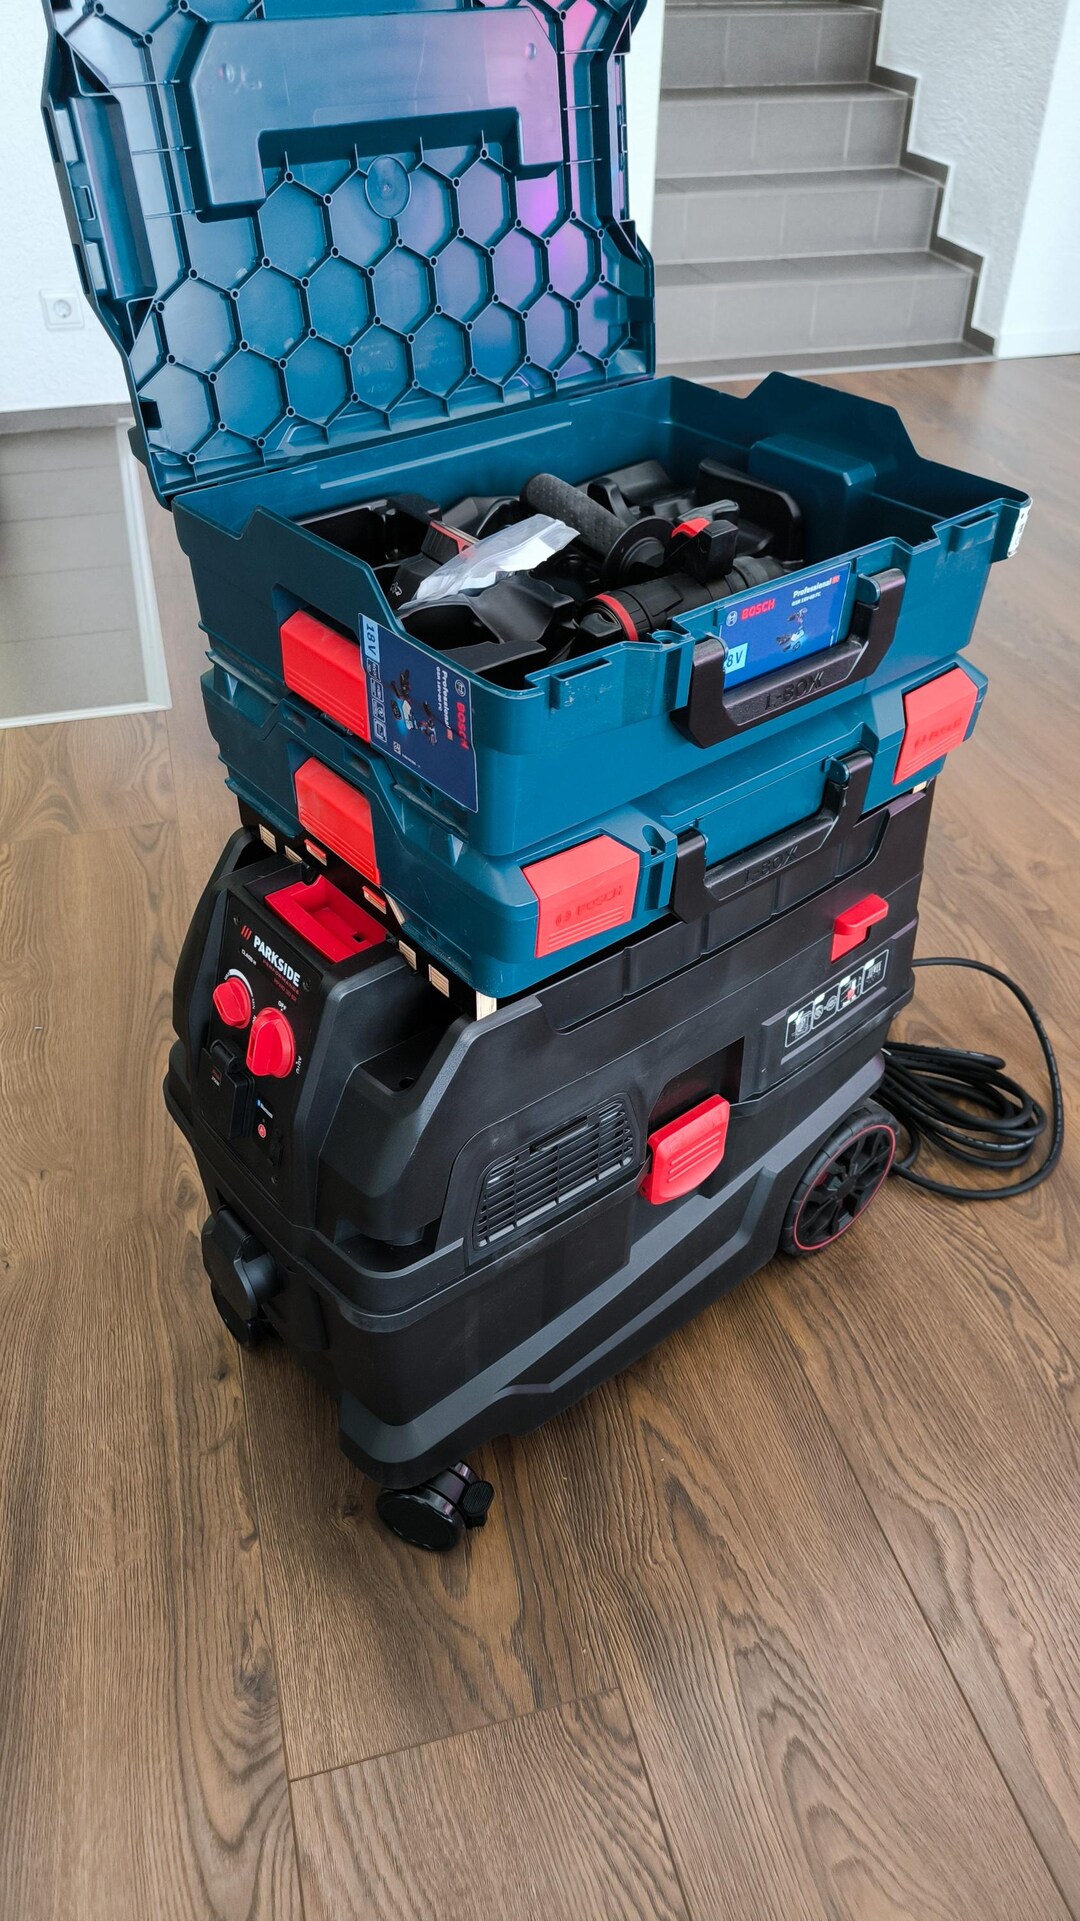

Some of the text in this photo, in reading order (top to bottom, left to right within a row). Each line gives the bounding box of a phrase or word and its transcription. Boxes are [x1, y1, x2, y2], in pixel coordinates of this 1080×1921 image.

[741, 598, 776, 620] BOSCH
[456, 702, 469, 750] BOSCH
[253, 935, 301, 988] PARKSIDE
